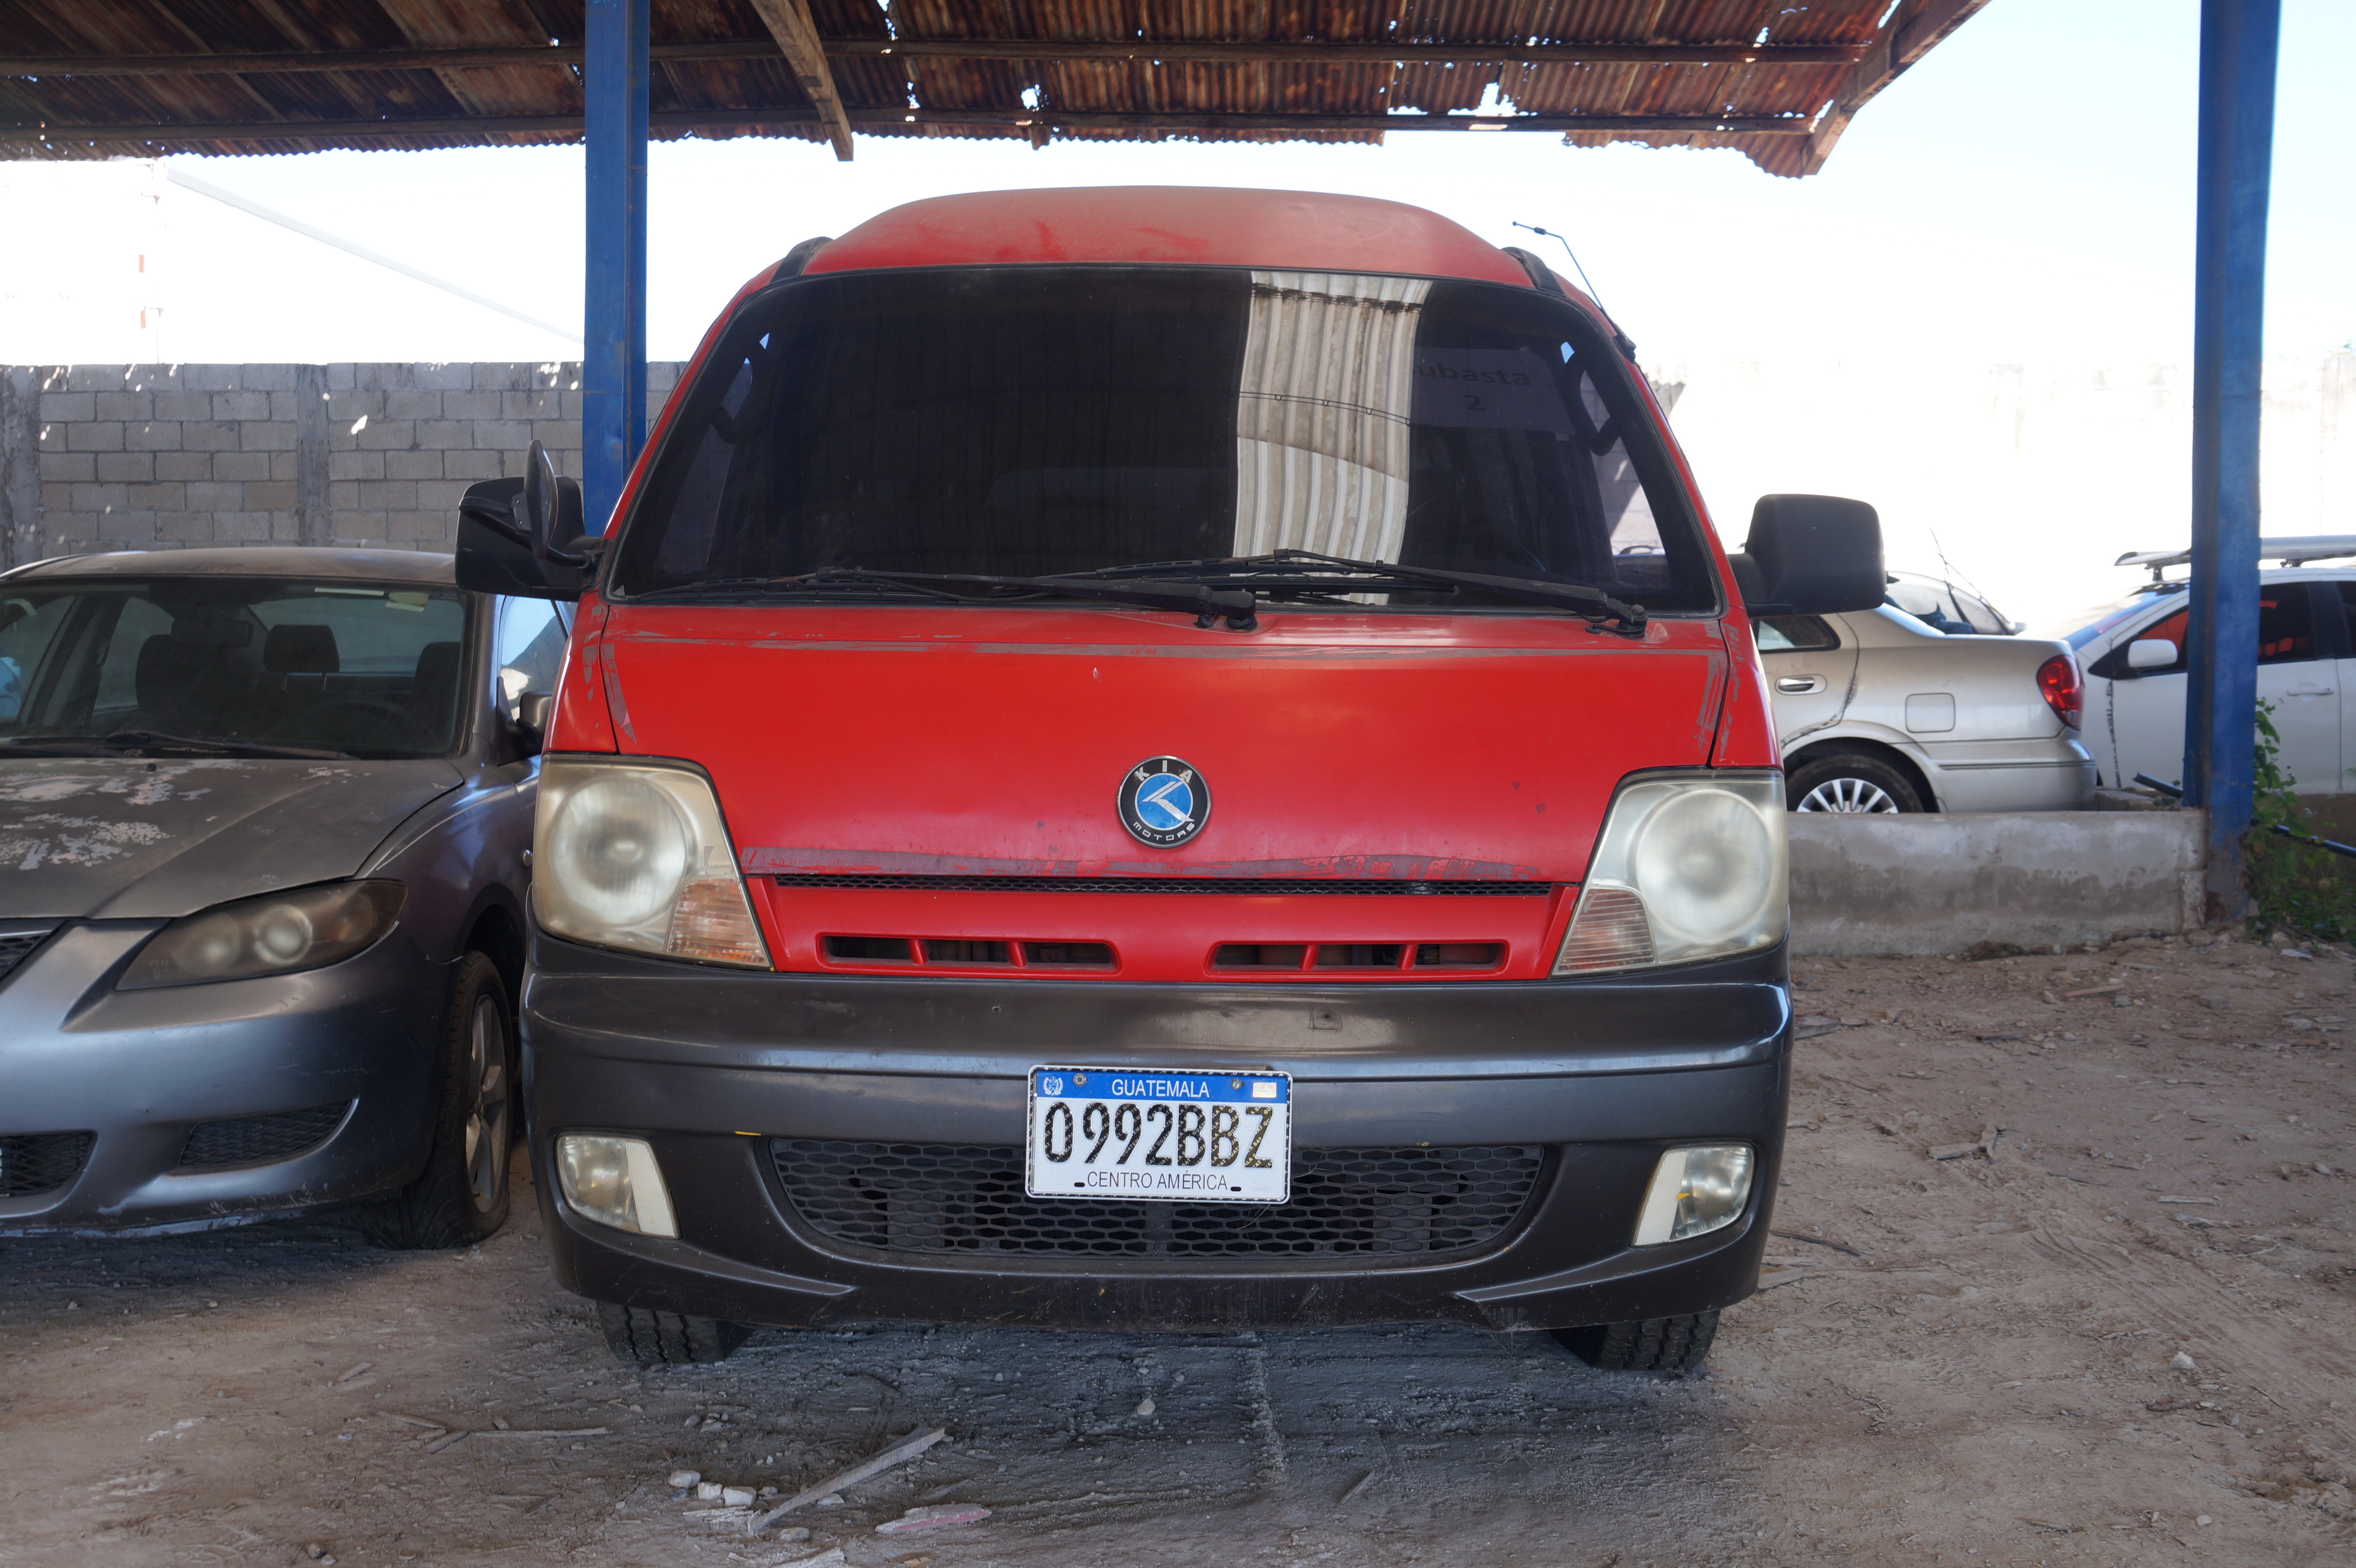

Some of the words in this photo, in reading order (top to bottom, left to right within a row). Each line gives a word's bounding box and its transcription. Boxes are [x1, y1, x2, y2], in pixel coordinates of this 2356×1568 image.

[1413, 362, 1531, 386] ubasta
[1463, 395, 1485, 411] 2
[1135, 760, 1193, 783] KIA
[1133, 821, 1195, 841] MOTORS
[1112, 1079, 1210, 1098] GUATEMALA
[1044, 1100, 1274, 1168] 0992BBZ
[1253, 1136, 1262, 1147] SAT
[1087, 1171, 1153, 1189] CENTRO
[1157, 1170, 1228, 1190] AMÉRICA
